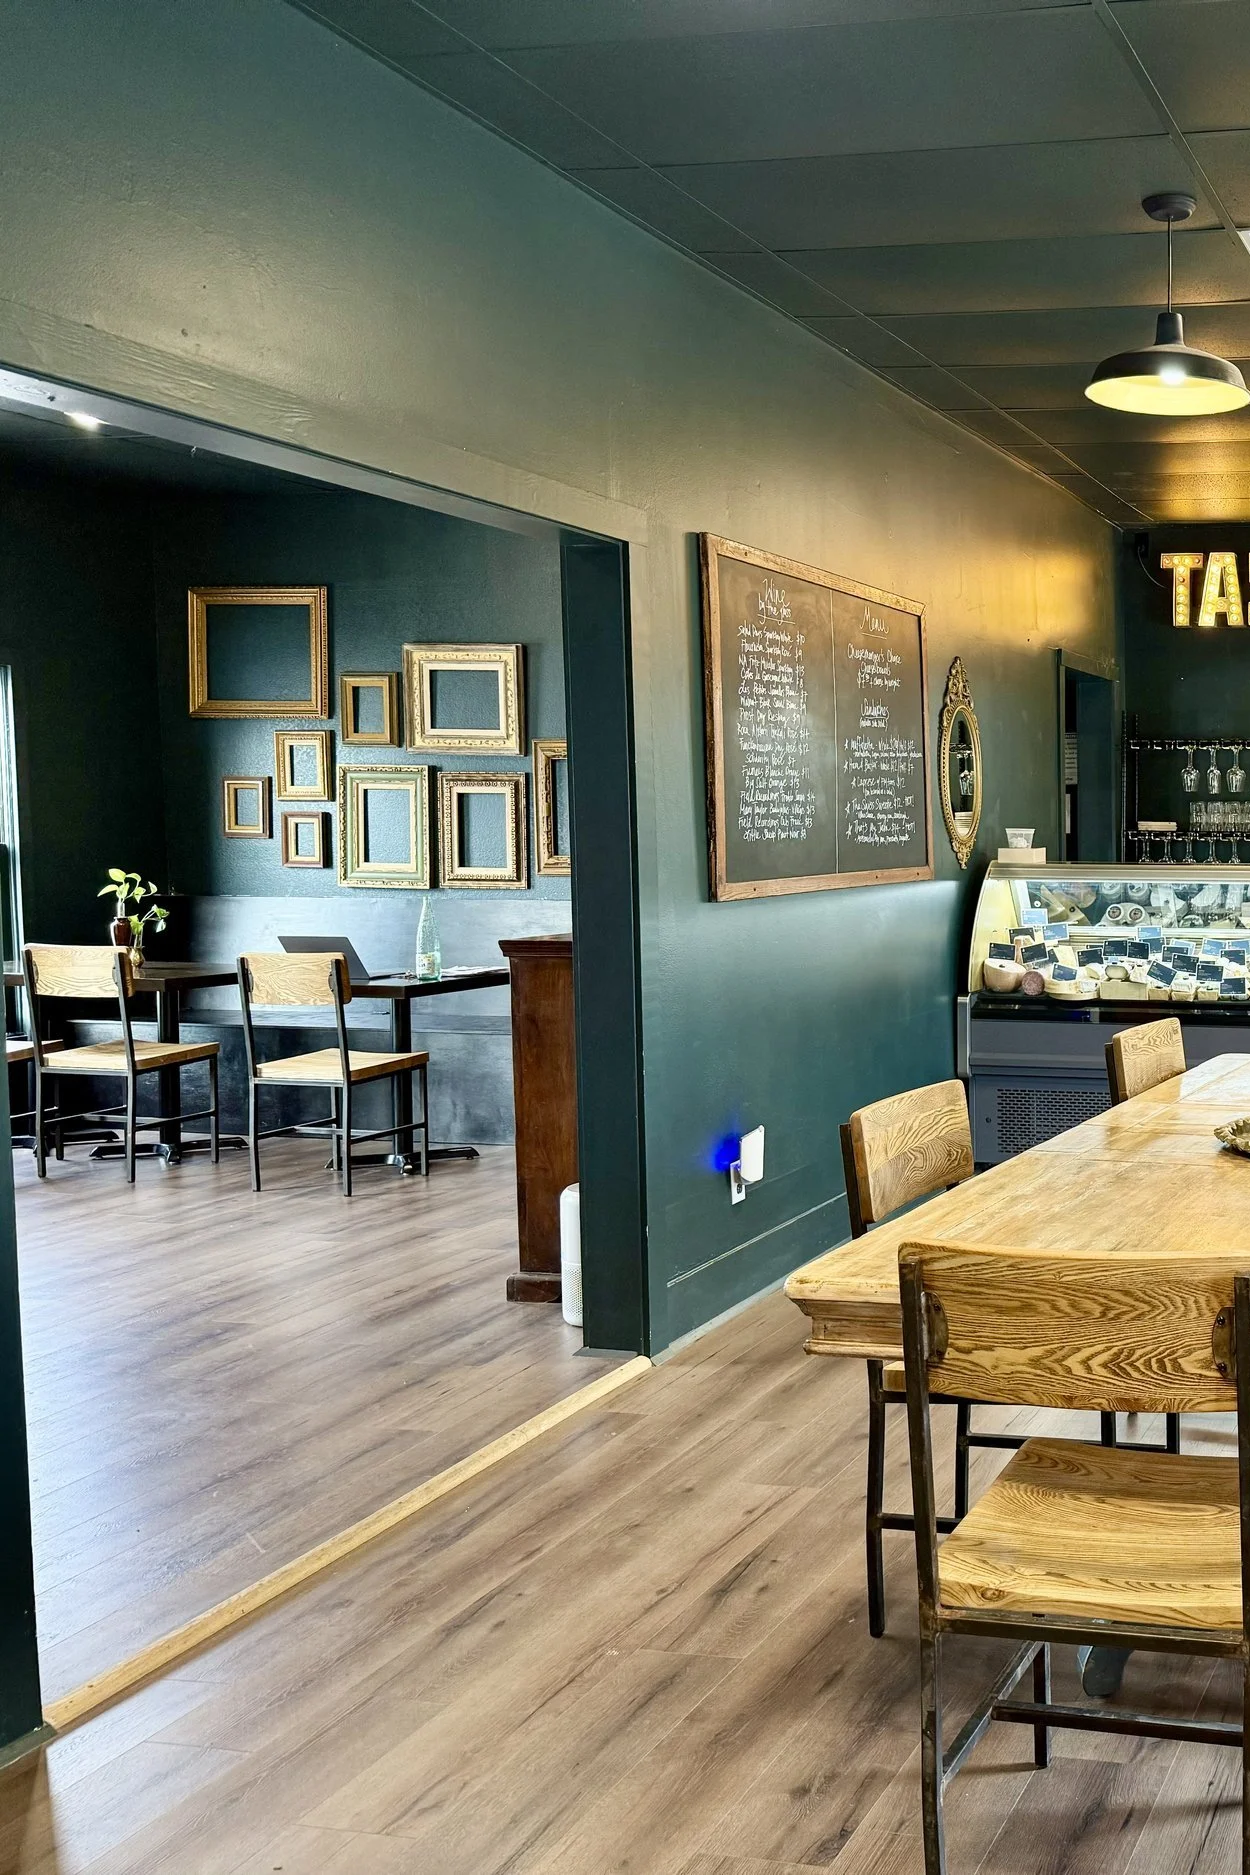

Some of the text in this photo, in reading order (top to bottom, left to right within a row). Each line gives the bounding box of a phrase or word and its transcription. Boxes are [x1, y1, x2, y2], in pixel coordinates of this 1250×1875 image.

[763, 579, 791, 607] Wine
[766, 600, 779, 616] the
[860, 606, 889, 634] Menu
